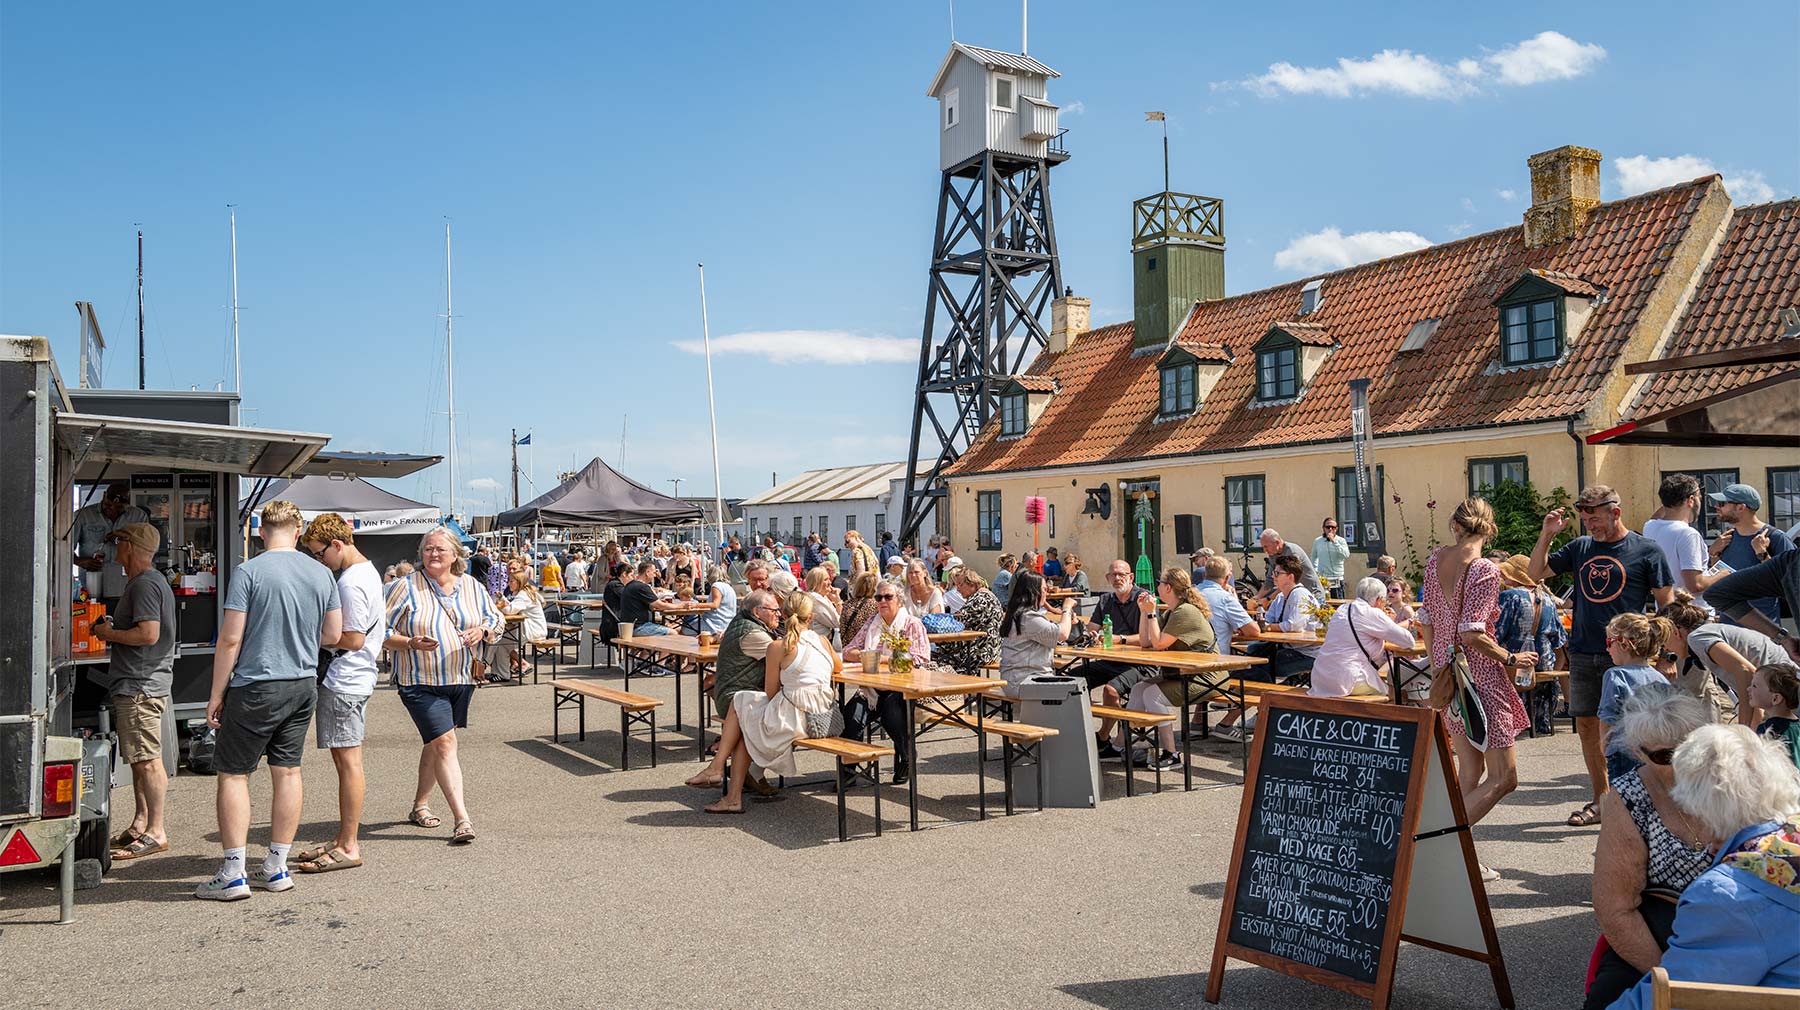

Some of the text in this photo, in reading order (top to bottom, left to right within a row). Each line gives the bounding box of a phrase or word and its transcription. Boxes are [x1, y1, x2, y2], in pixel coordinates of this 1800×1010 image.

[1277, 713, 1325, 740] CAKE
[1325, 720, 1339, 740] &
[1272, 742, 1409, 773] DAGENS LÆKRE HJEMMEBAGTE
[1312, 762, 1349, 782] KAGER
[1264, 781, 1287, 798] FLAT
[1260, 810, 1286, 829] VARM
[1287, 814, 1340, 836] CHOKOLADE
[1261, 796, 1285, 811] CHAI
[1322, 803, 1369, 825] ISKAFFE
[1279, 837, 1304, 856] MED
[1306, 842, 1335, 862] KAGE
[1249, 883, 1300, 905] LEMONADE
[1250, 869, 1294, 891] CHAPLON
[1299, 879, 1311, 897] TE
[1267, 900, 1293, 921] MED
[1294, 905, 1325, 928] KAGE
[1240, 917, 1275, 938] EKSTRA
[1270, 939, 1327, 967] KAFFESIRUP
